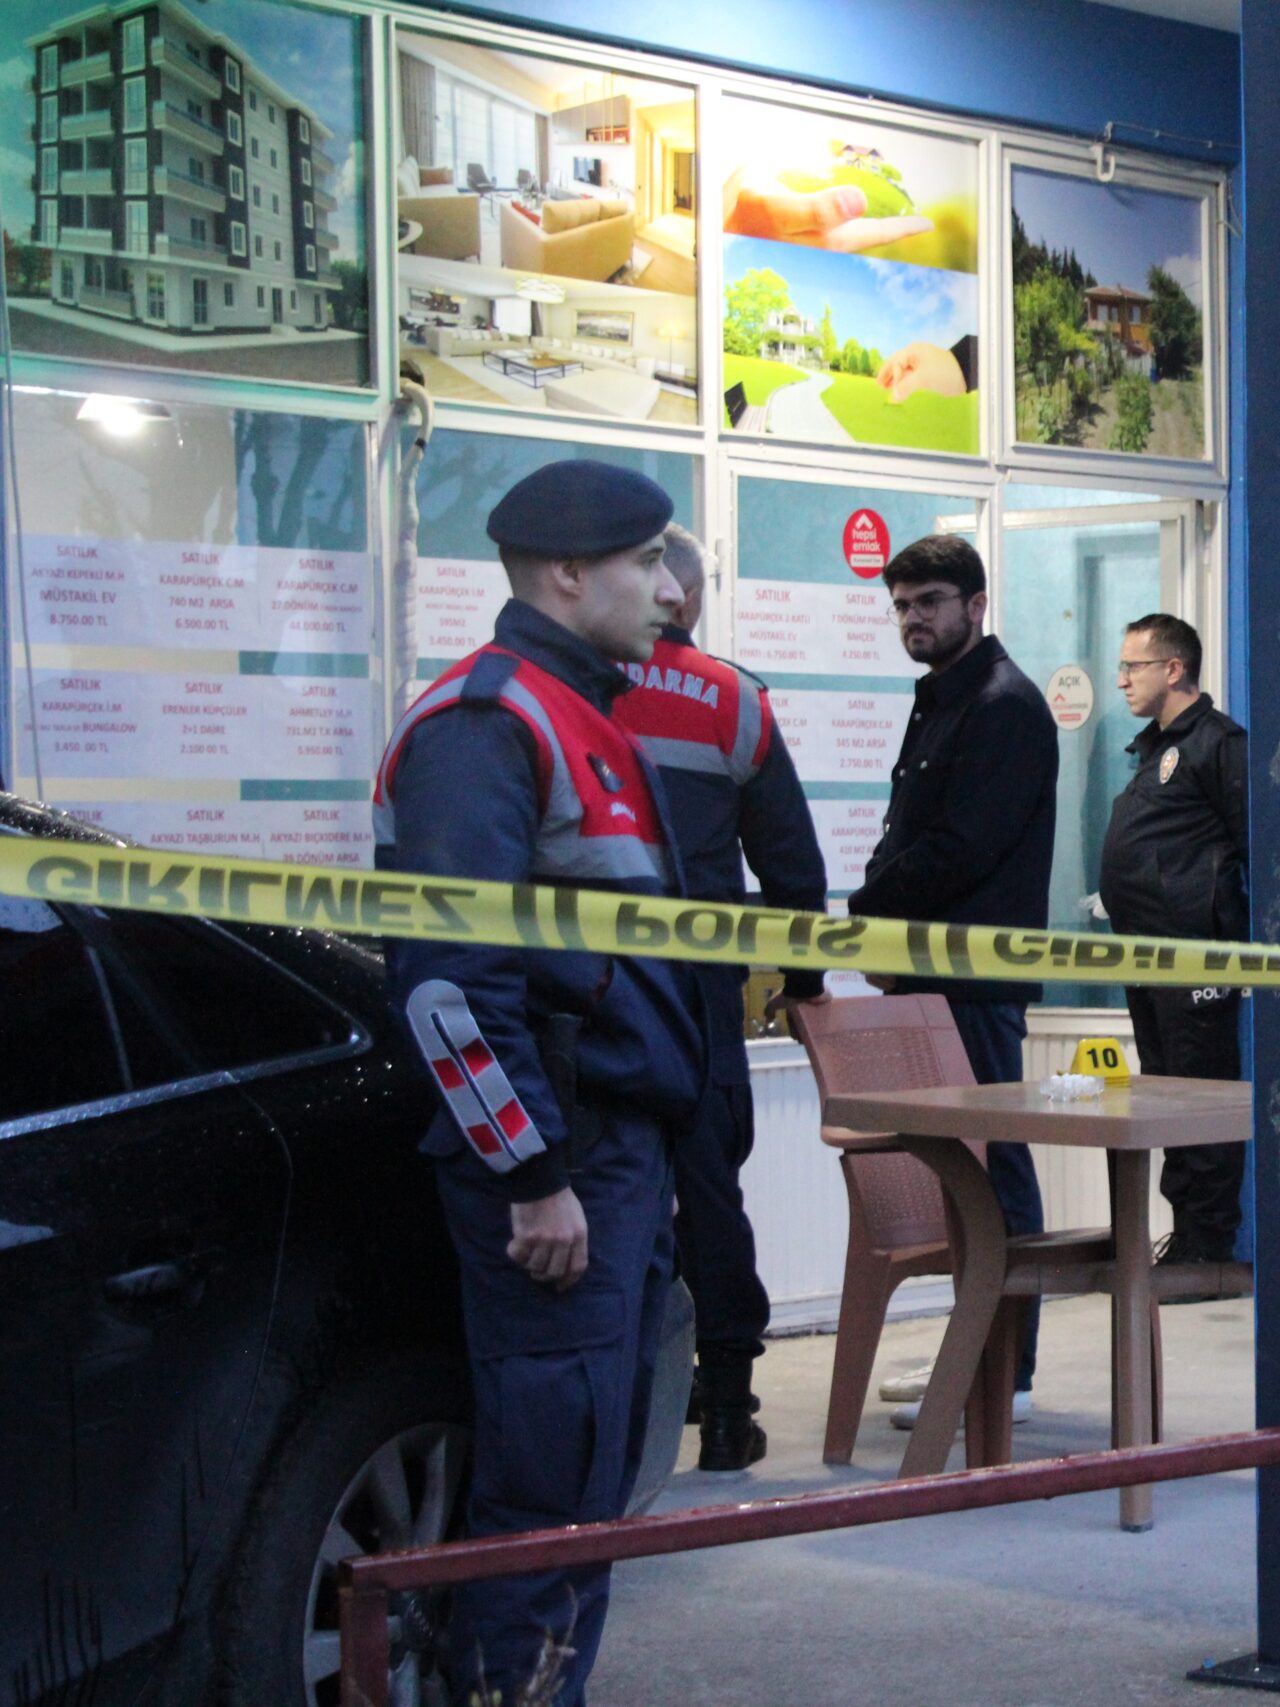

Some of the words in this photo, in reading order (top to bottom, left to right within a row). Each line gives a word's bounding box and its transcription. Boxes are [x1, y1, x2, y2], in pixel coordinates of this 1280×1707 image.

[852, 527, 877, 541] hepsi
[853, 541, 881, 552] emlak
[182, 552, 220, 565] SATILIK
[299, 559, 335, 571] SATILIK
[437, 567, 467, 578] SATILIK
[755, 589, 791, 602] SATILIK
[846, 593, 877, 605] SATILIK
[60, 678, 101, 691] SATILIK
[185, 682, 224, 694] SATILIK
[617, 662, 719, 710] DARMA
[1058, 676, 1081, 689] AÇIK
[302, 686, 336, 697] SATILIK
[848, 700, 875, 710] SATILIK
[187, 810, 225, 822] SATILIK
[304, 810, 340, 822] SATILIK
[848, 807, 876, 818] SATILIK
[1086, 1047, 1119, 1069] 10
